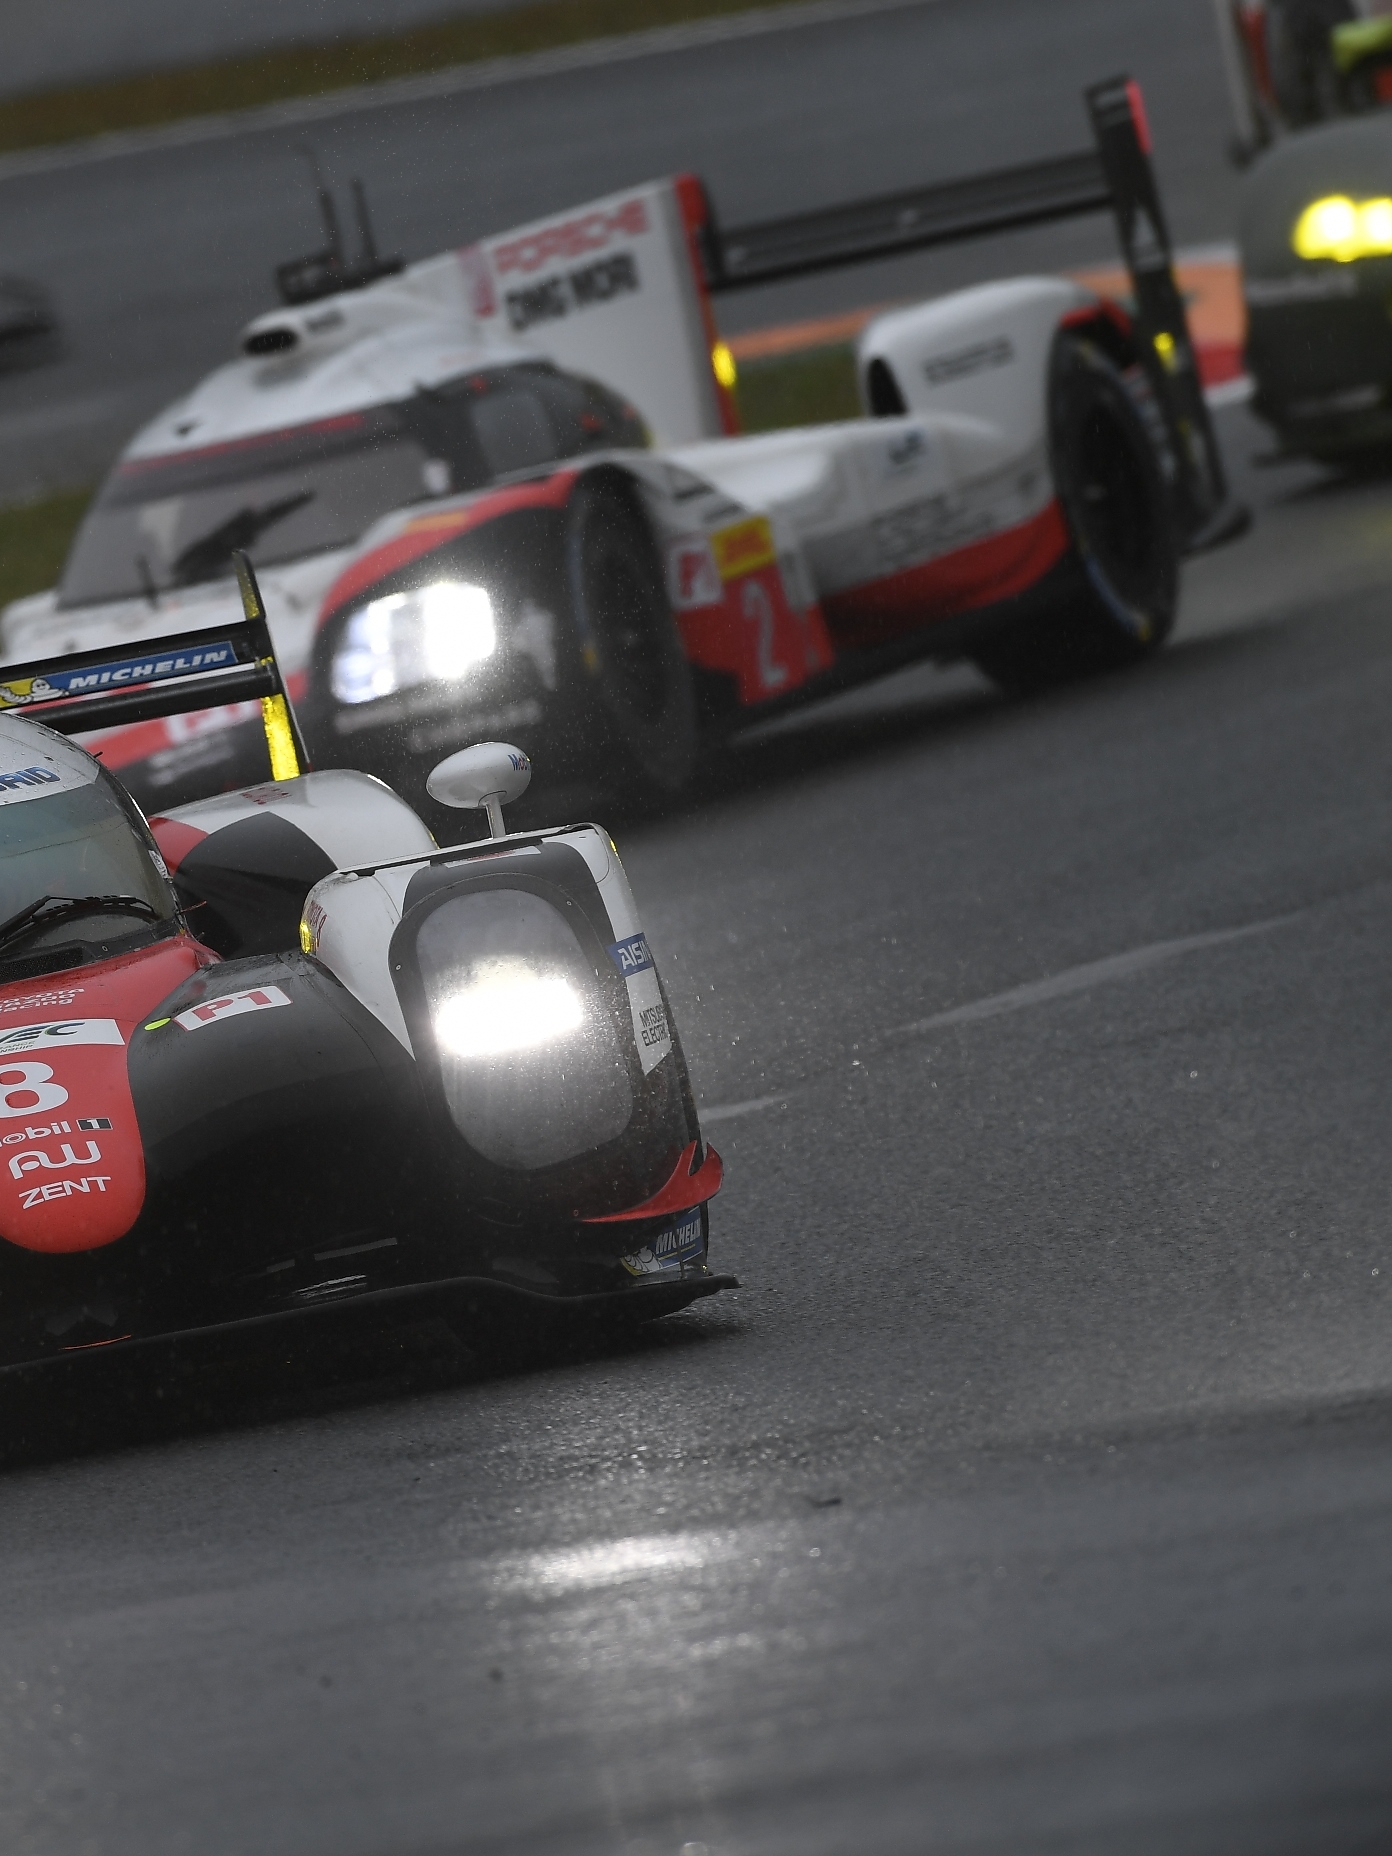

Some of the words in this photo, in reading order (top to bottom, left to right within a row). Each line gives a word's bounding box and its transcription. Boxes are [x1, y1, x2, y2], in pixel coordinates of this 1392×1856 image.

[68, 650, 228, 689] MICHELIN
[192, 991, 272, 1021] P1
[18, 1176, 111, 1209] ZENT
